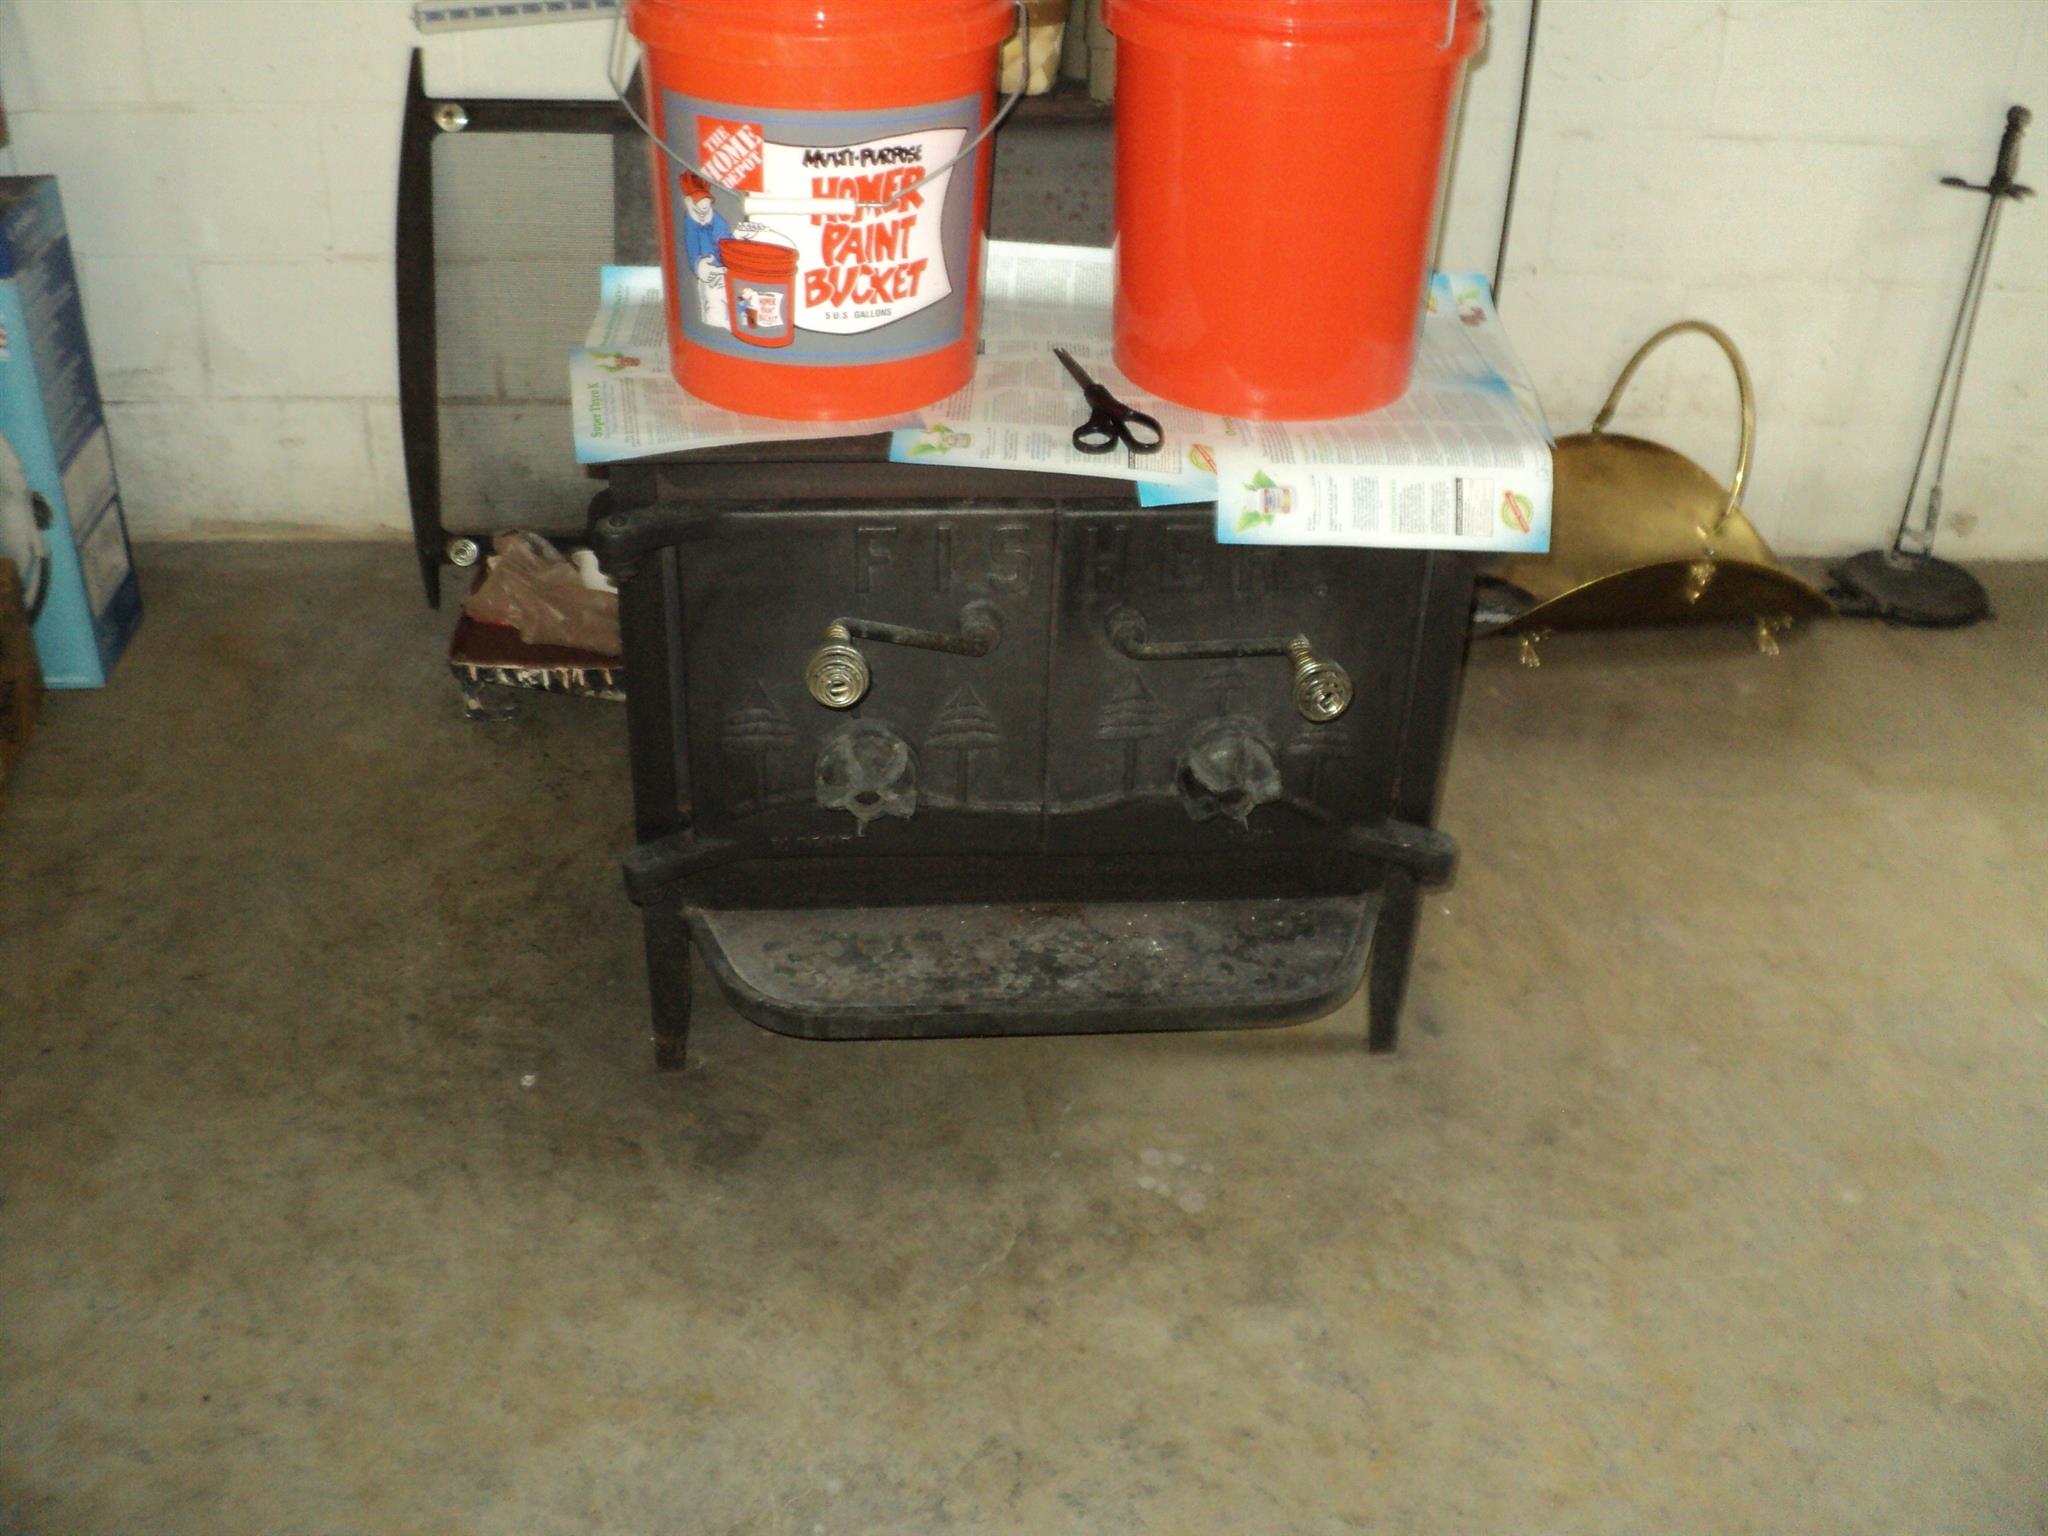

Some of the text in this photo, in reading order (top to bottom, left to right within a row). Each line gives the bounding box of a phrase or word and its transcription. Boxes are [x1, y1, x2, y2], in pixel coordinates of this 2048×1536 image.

[701, 124, 764, 183] HOME
[703, 126, 730, 152] THE
[802, 144, 923, 168] MULTI-PURPOSE
[721, 150, 763, 189] DEPOT
[810, 165, 926, 226] HOMER
[821, 214, 917, 267] PAINT
[803, 257, 929, 308] BUCKET
[854, 308, 892, 319] GALLONS
